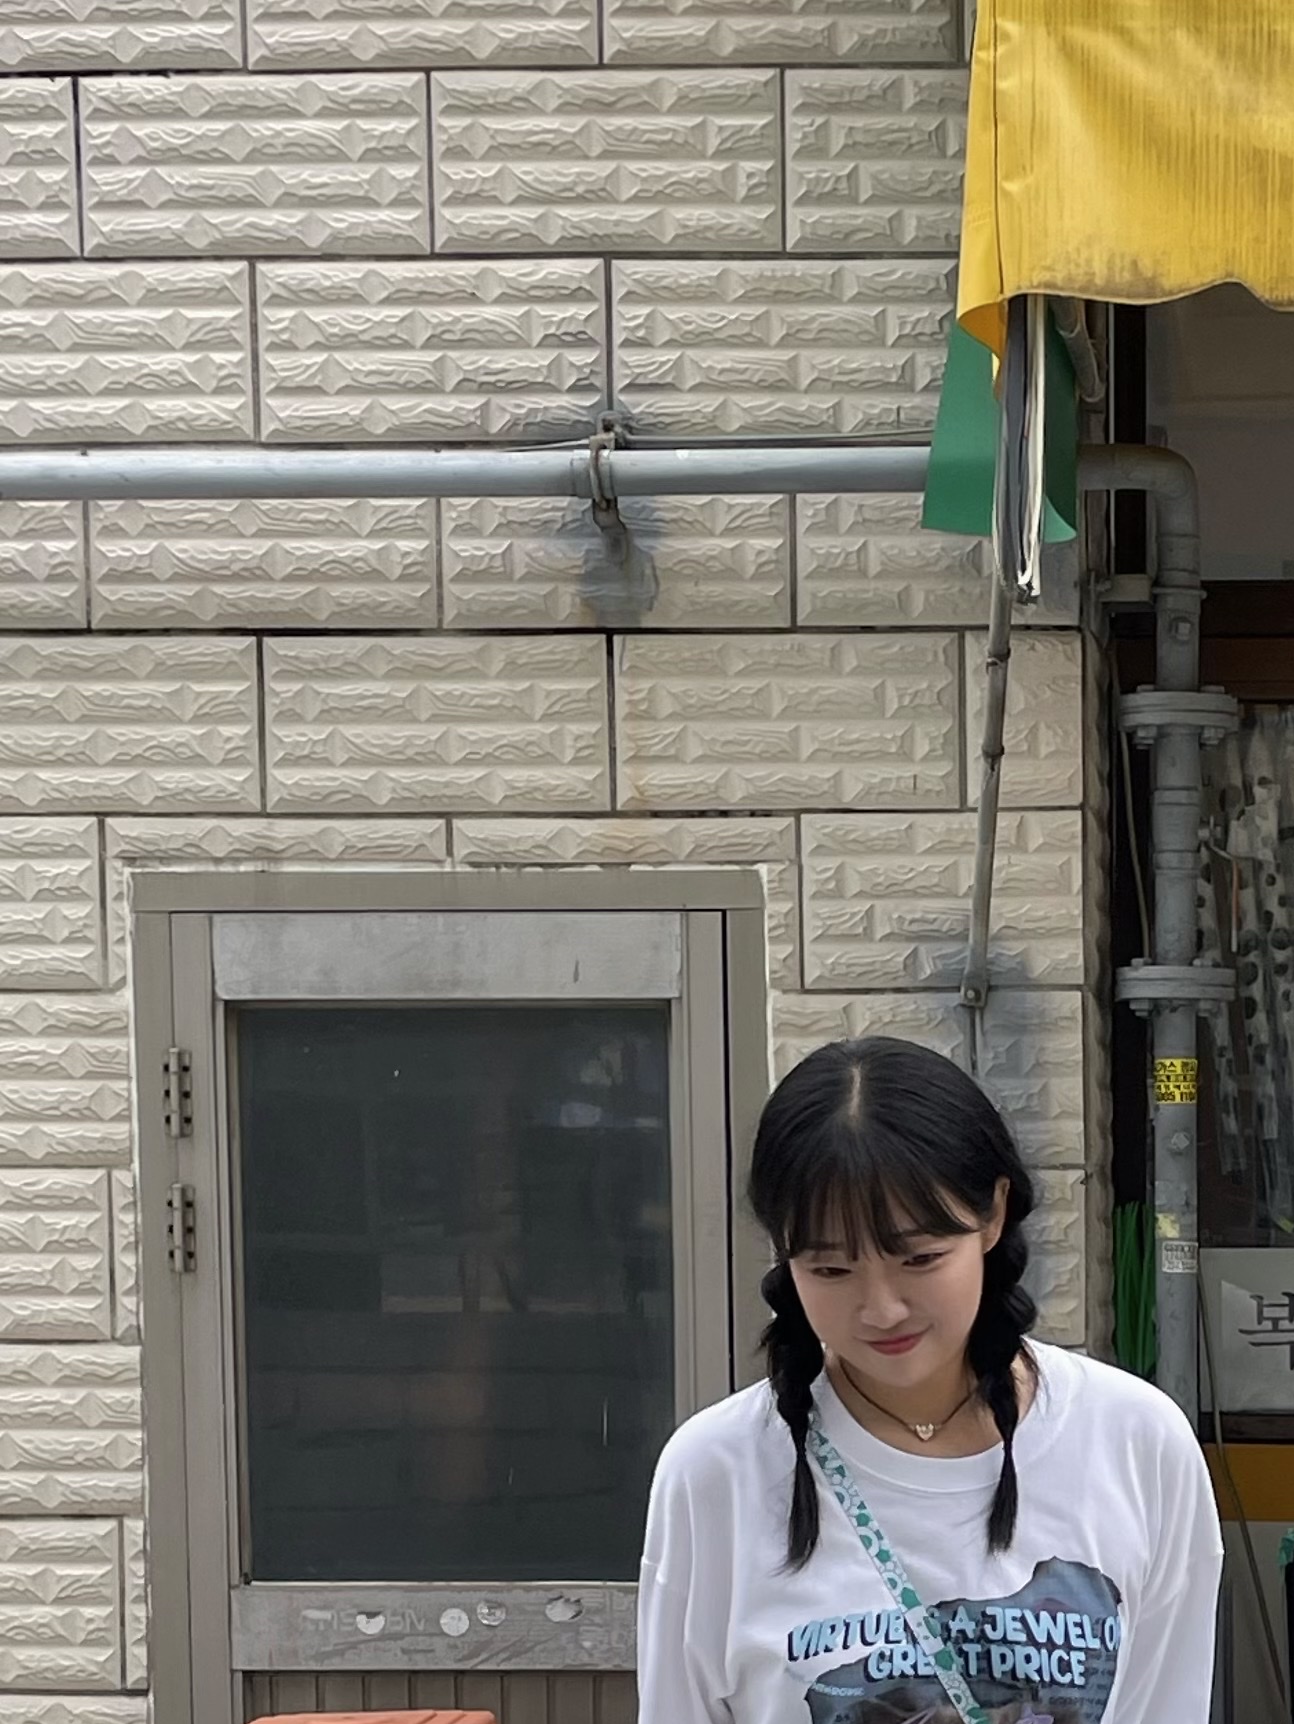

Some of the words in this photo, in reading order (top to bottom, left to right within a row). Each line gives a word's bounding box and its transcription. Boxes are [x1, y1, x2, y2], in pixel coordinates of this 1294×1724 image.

[788, 1608, 906, 1661] VIRTUE
[948, 1604, 977, 1642] A
[983, 1606, 1100, 1650] JEWEL
[866, 1644, 981, 1683] GRET
[990, 1643, 1087, 1686] PRICE
